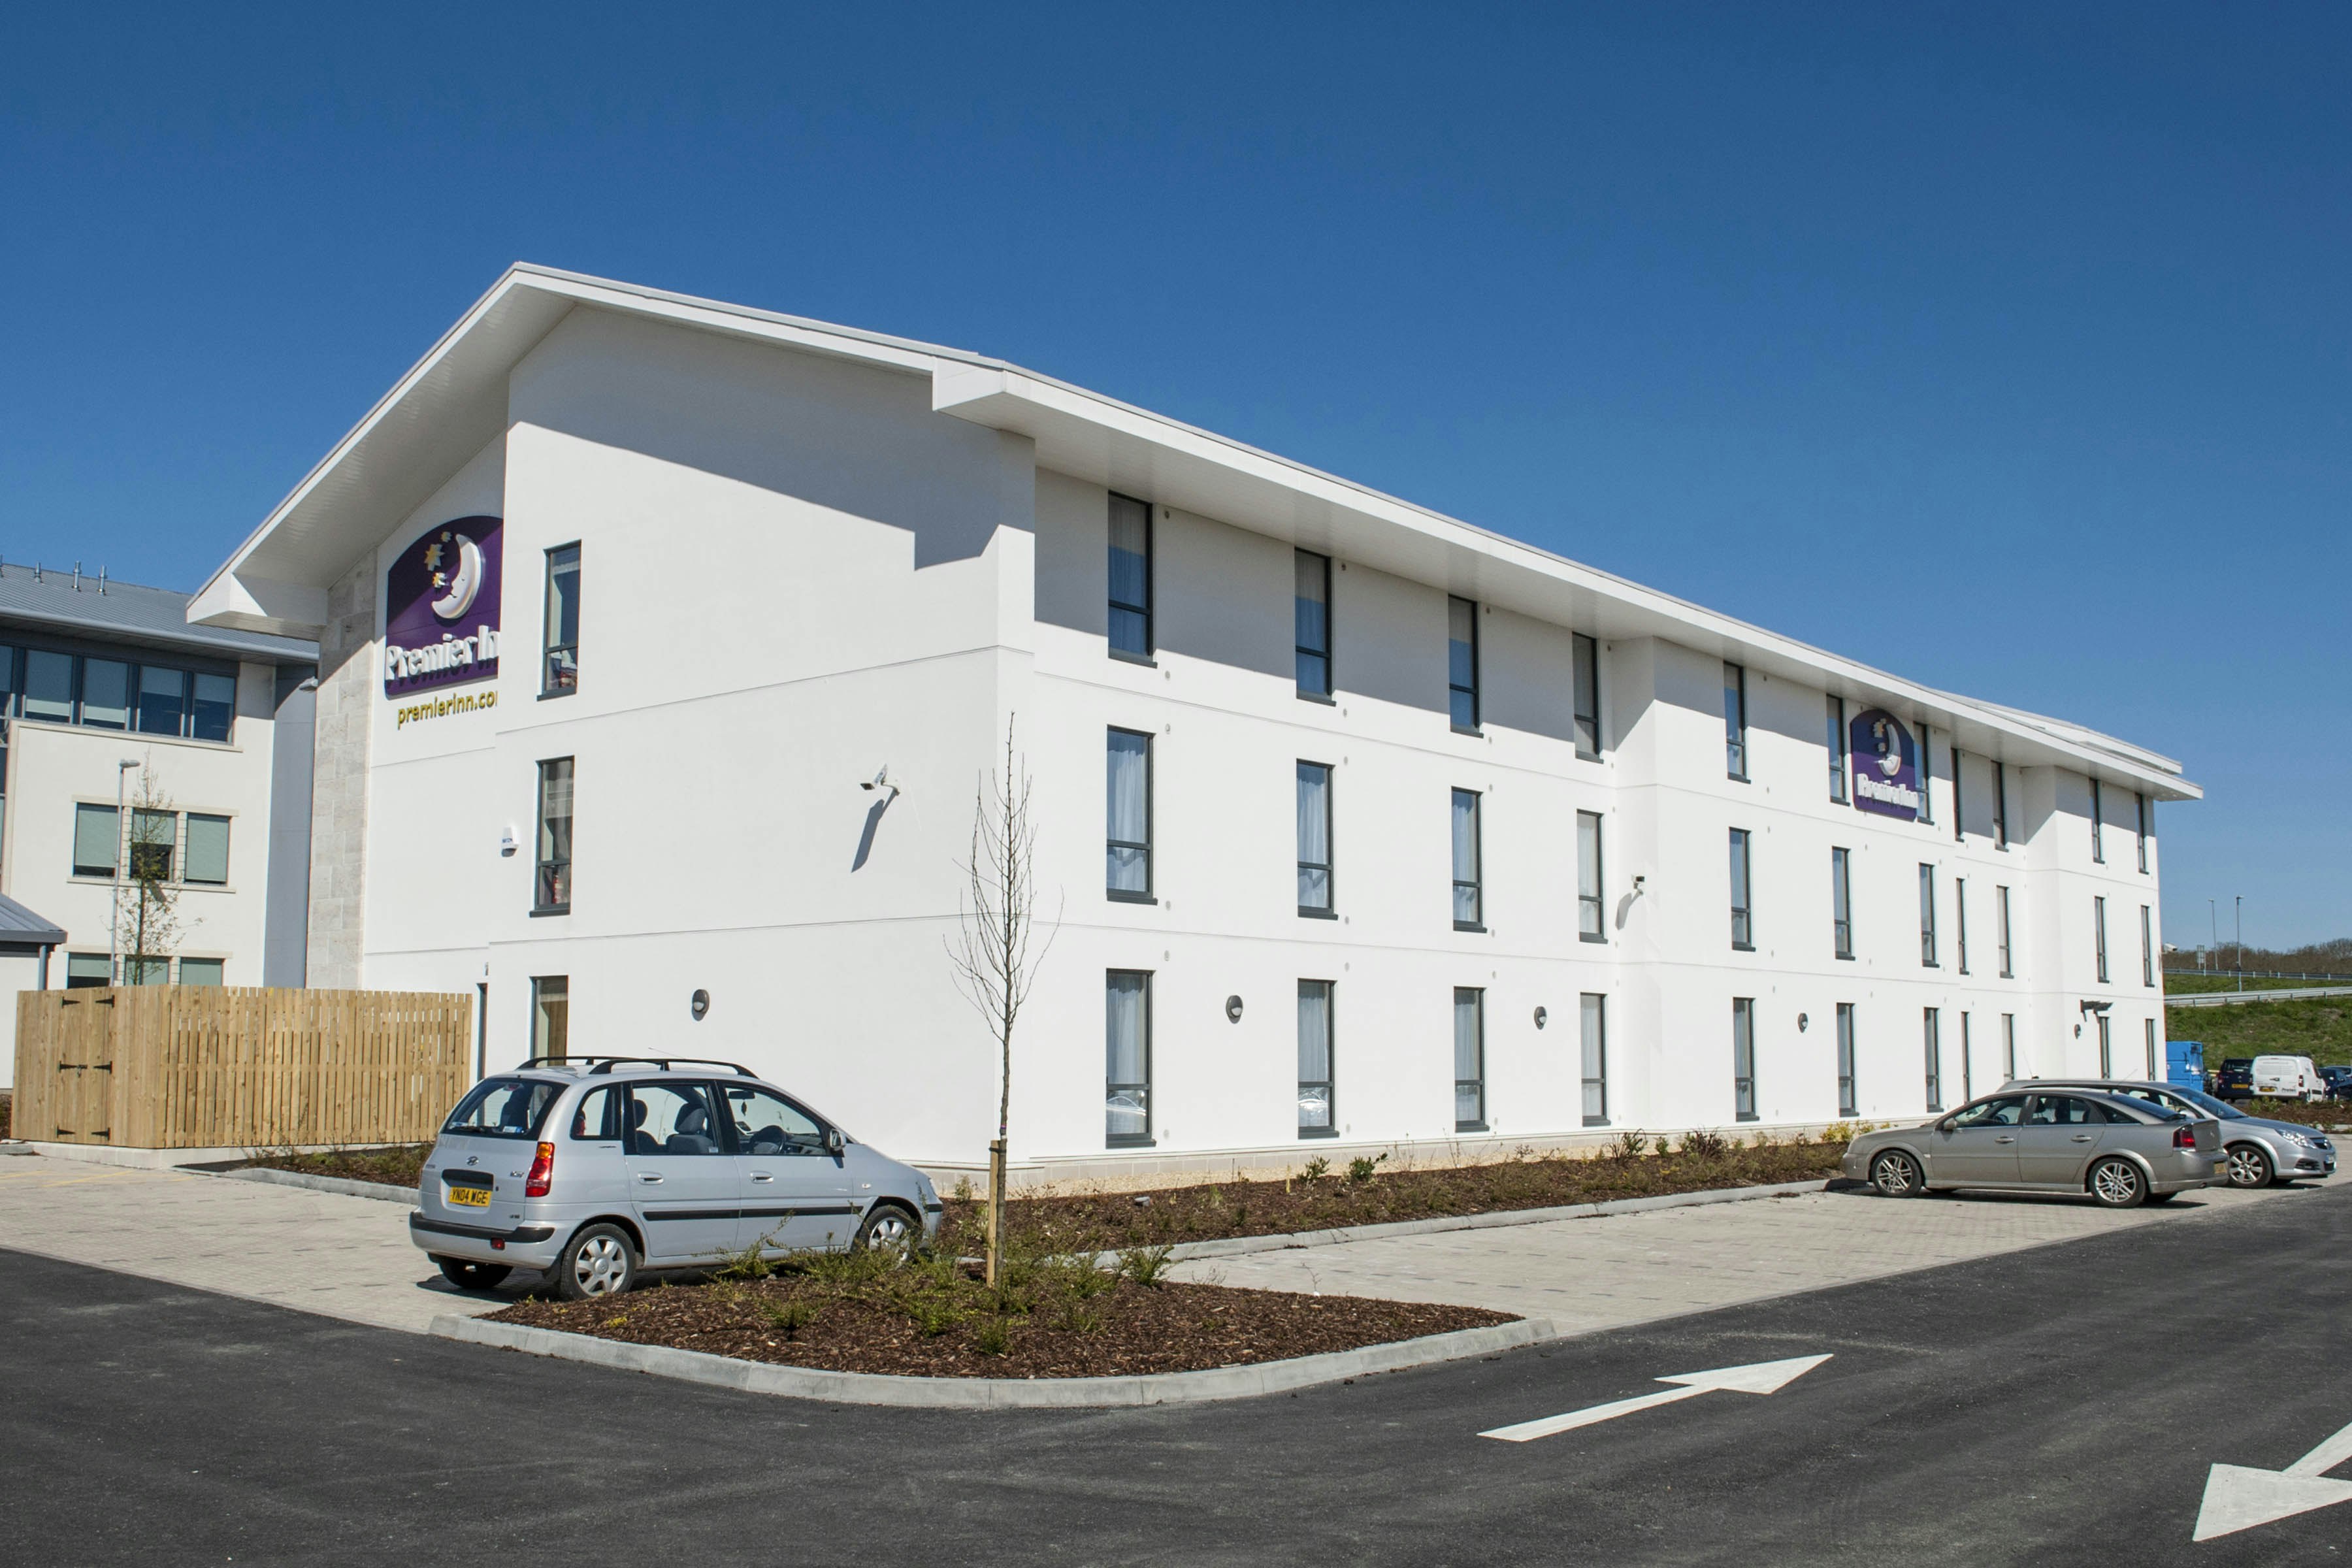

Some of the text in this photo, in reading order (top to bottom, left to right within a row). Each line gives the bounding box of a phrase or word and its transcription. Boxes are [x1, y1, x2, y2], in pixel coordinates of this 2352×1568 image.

[385, 625, 500, 679] Premier In
[398, 690, 498, 730] premierinn.co
[451, 1187, 489, 1204] YN04 WGE
